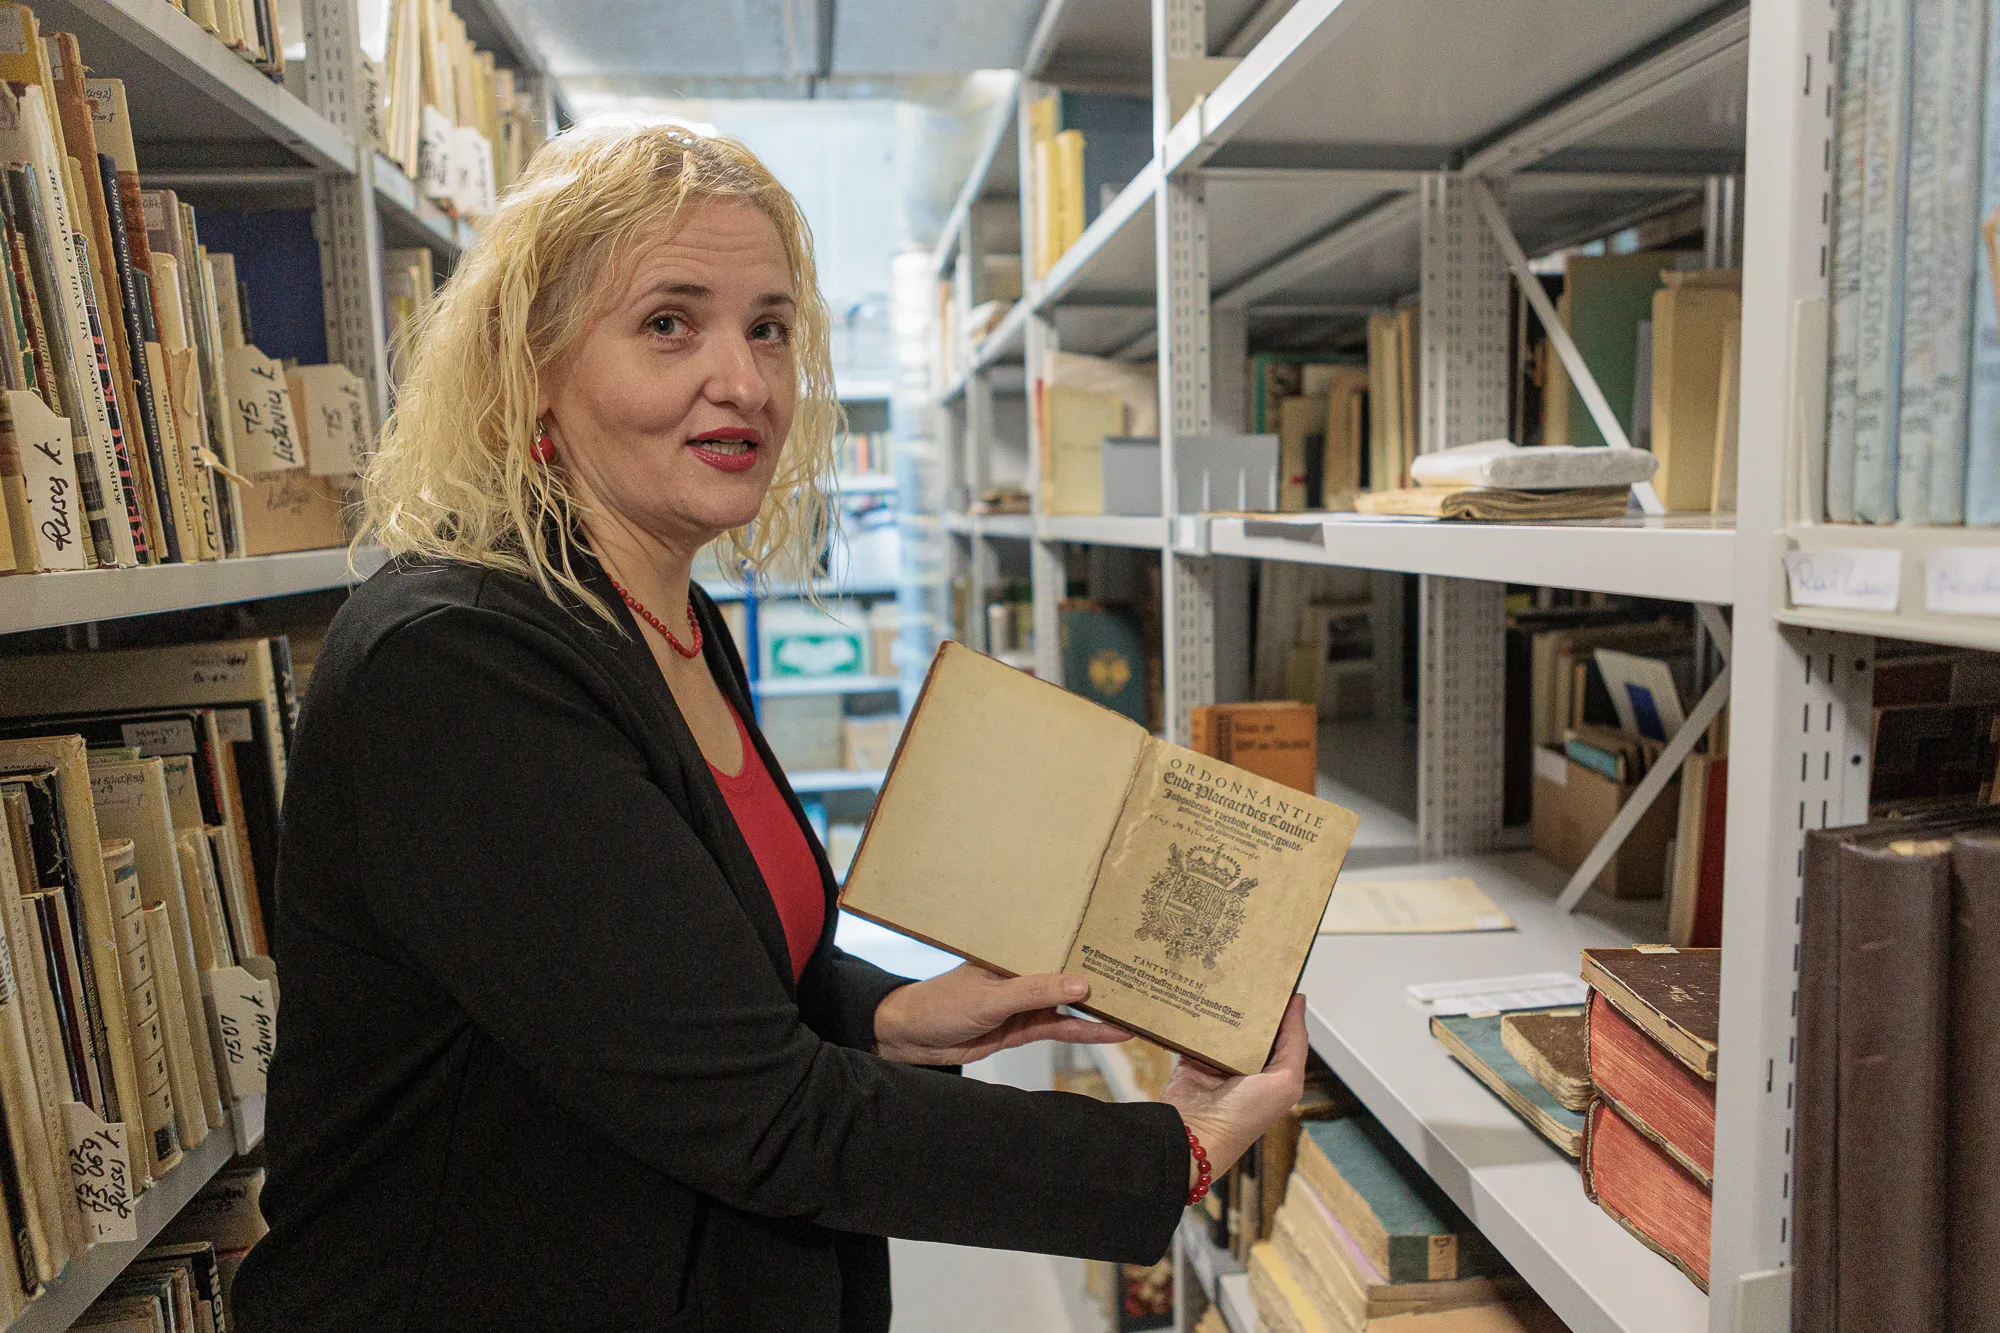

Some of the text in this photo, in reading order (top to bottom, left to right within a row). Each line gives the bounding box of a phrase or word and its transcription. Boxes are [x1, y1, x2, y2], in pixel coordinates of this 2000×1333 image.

[109, 176, 121, 212] ВЕКА
[115, 215, 124, 234] XV
[118, 235, 137, 310] ЖИВОПИСЬ
[238, 398, 261, 435] 75
[1170, 758, 1324, 829] ORDONNANTIE
[1247, 805, 1267, 823] des
